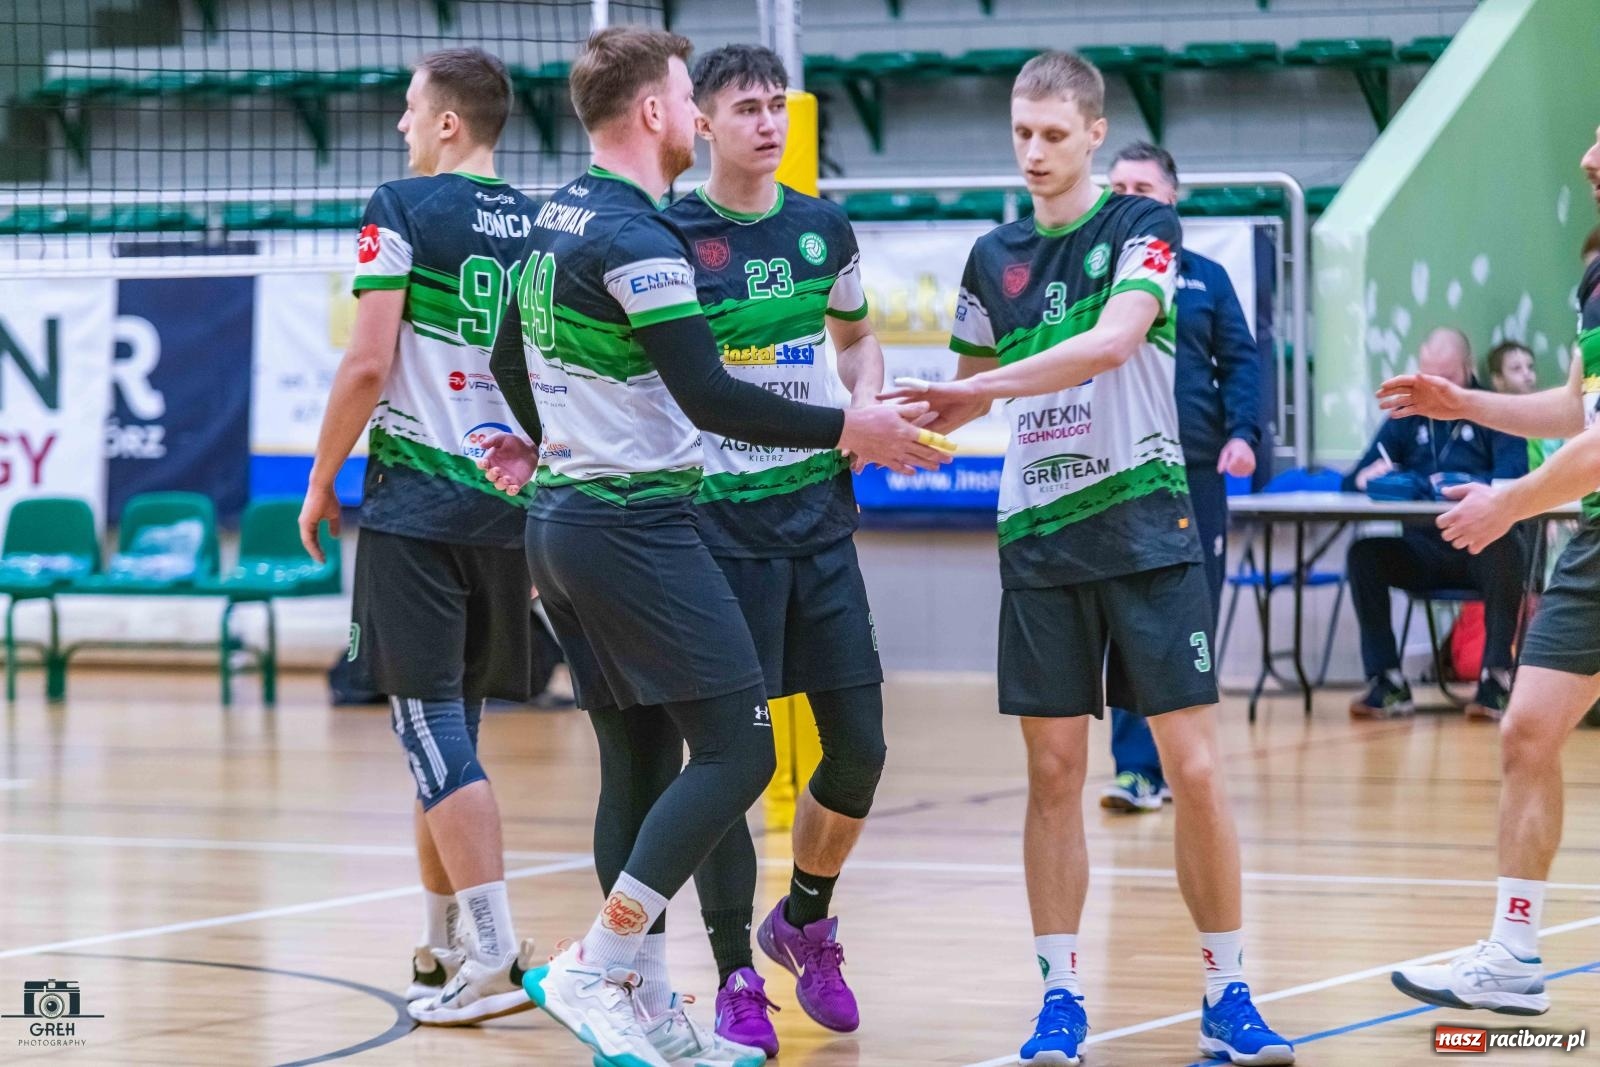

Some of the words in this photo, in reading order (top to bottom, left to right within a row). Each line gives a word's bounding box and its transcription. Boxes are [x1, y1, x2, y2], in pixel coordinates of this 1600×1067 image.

[745, 258, 794, 300] 23
[457, 254, 521, 348] 9
[518, 250, 557, 351] 49
[1043, 282, 1067, 325] 3
[110, 314, 167, 420] R
[723, 344, 815, 363] instal-tech
[762, 382, 810, 400] EXIN
[1017, 402, 1092, 432] PIVEXIN
[1017, 423, 1092, 445] TECHNOLOGY
[749, 454, 783, 462] KIETRZ
[1189, 631, 1212, 673] 3
[1508, 897, 1532, 918] R
